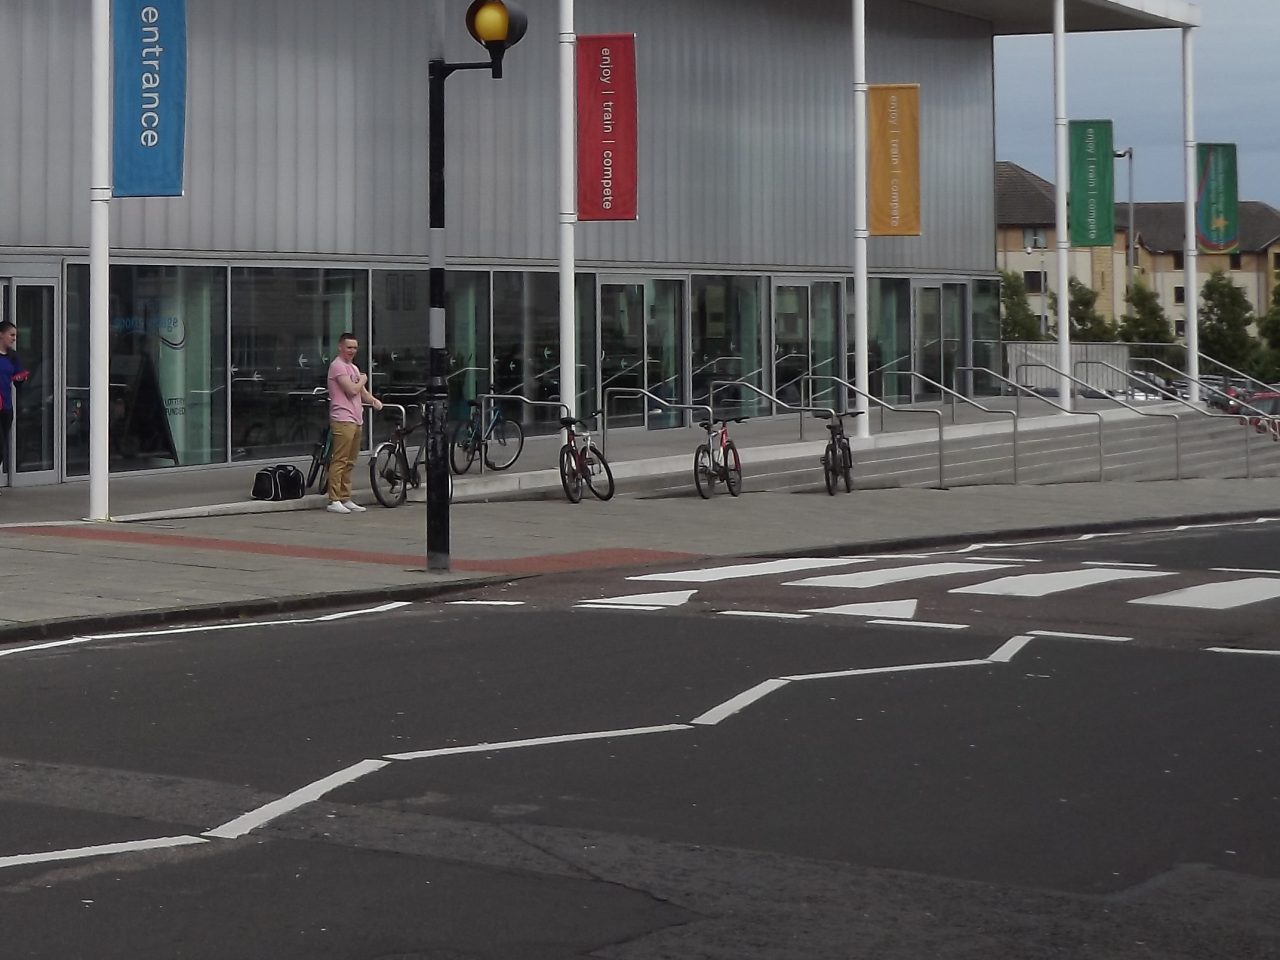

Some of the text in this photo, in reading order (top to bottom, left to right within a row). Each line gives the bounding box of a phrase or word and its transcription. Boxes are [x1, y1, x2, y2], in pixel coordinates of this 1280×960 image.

[140, 6, 163, 147] entrance
[600, 47, 613, 84] enjoy
[602, 102, 615, 133] train
[1085, 128, 1095, 153] enjoy
[600, 150, 615, 209] compete
[1088, 165, 1097, 187] train
[1087, 198, 1097, 239] compete
